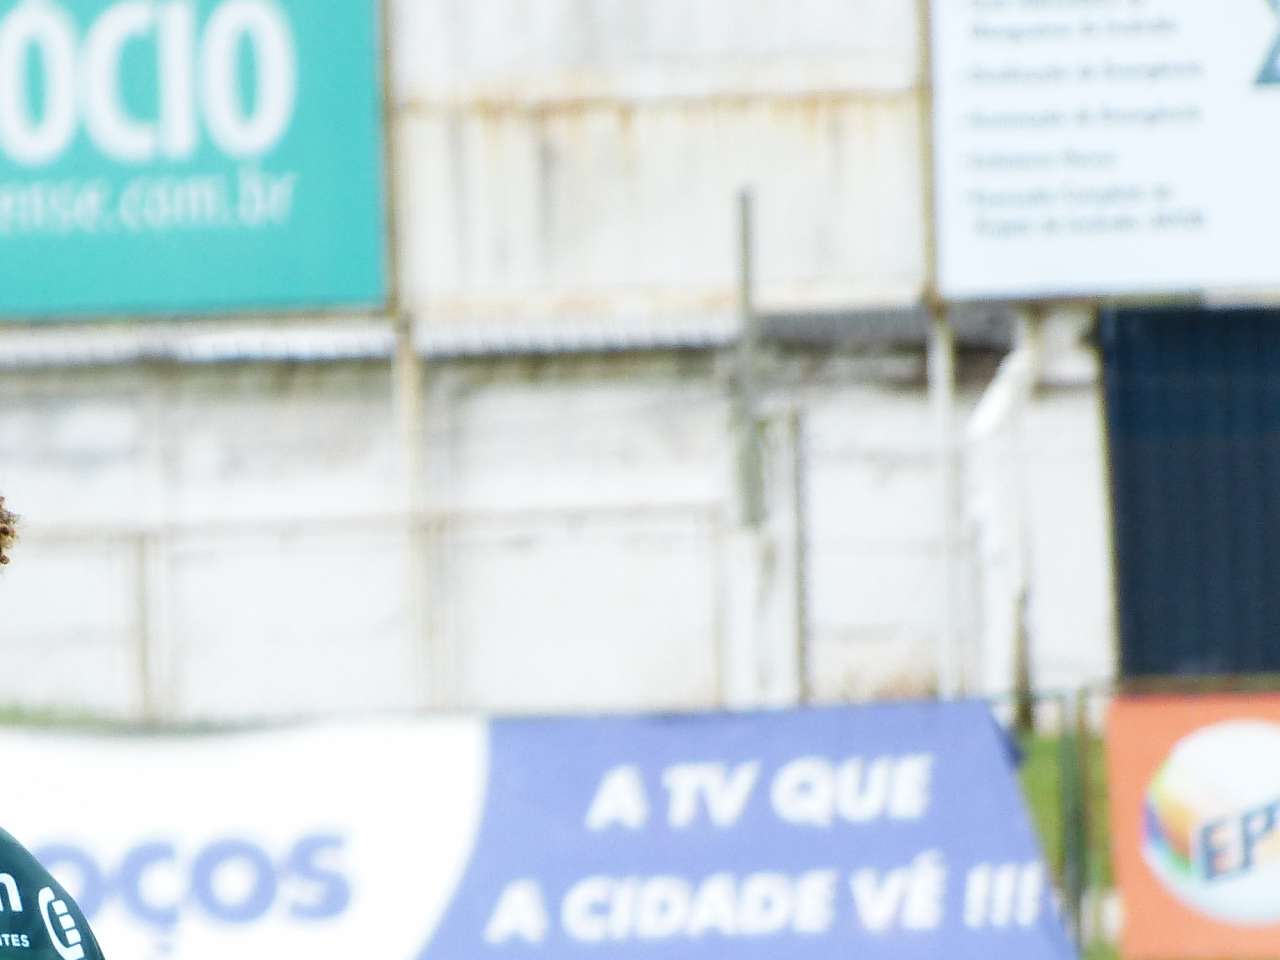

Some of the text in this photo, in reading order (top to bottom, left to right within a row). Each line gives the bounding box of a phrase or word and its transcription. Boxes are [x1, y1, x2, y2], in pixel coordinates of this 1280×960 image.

[585, 751, 936, 829] A TV QUE
[484, 878, 548, 945] A
[561, 868, 838, 944] CIDADE
